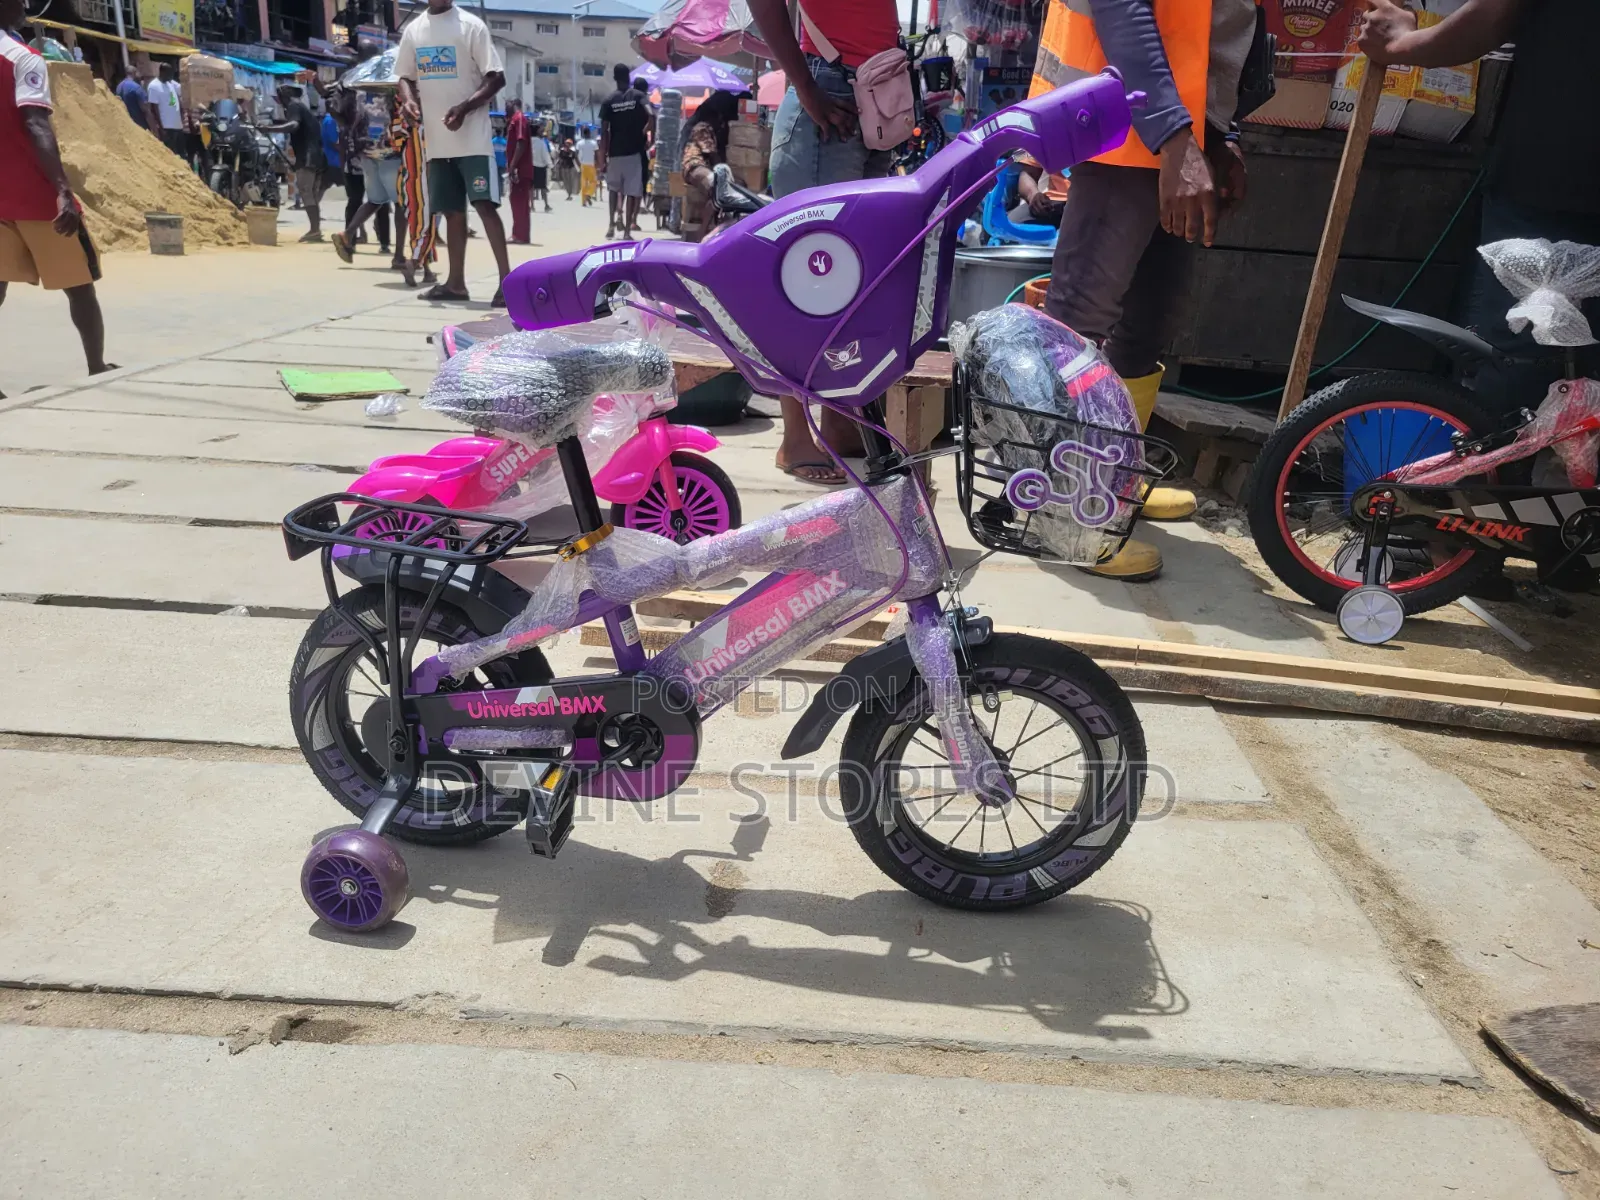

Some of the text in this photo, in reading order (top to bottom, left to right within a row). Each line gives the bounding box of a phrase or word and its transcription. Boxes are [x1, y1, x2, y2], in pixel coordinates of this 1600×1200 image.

[1283, 0, 1336, 14] MIMEE
[1329, 100, 1354, 113] 020
[773, 209, 826, 233] Universal BMX
[1435, 515, 1532, 542] LI-LINK
[762, 530, 820, 552] Universal BMX
[684, 569, 848, 684] Universal BMX
[467, 695, 607, 719] Universal BMX
